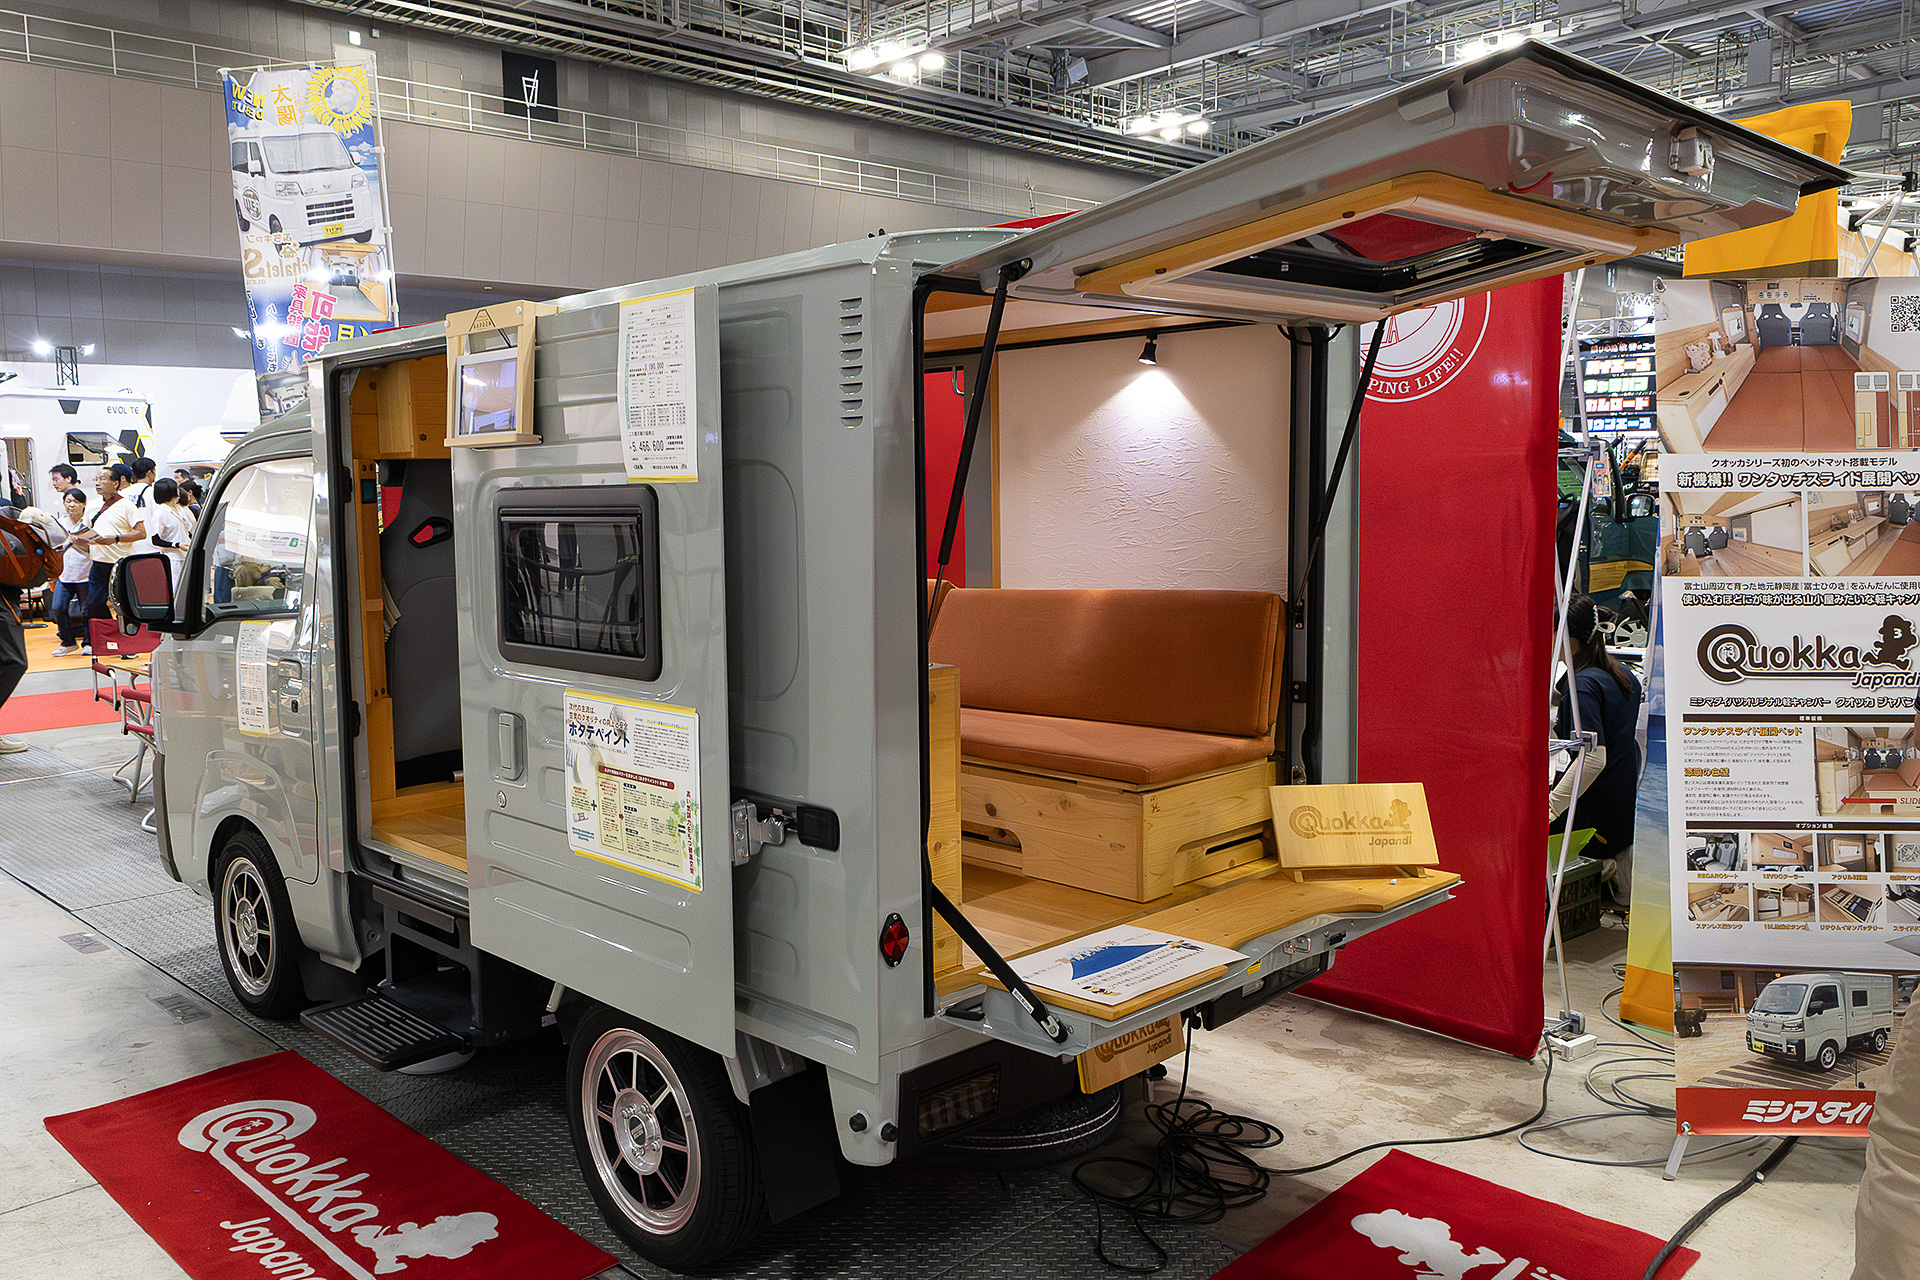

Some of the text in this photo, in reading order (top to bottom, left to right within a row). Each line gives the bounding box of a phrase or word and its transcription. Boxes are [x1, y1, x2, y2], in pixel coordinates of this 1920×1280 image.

[1367, 347, 1465, 394] PING LIFE!!
[1711, 457, 1898, 468] クオッカシリーズ初のベッドマット搭載モデル
[1677, 470, 1920, 487] 新機構!! ワンタッチスライド展開ベッ
[1697, 623, 1862, 683] Quokka
[1835, 697, 1875, 708] クオッカ
[568, 721, 630, 748] ホタテペイント
[1289, 805, 1384, 840] Quokka
[1369, 835, 1412, 848] Japandi
[178, 1099, 379, 1233] Quokka
[219, 1217, 327, 1280] Japan
